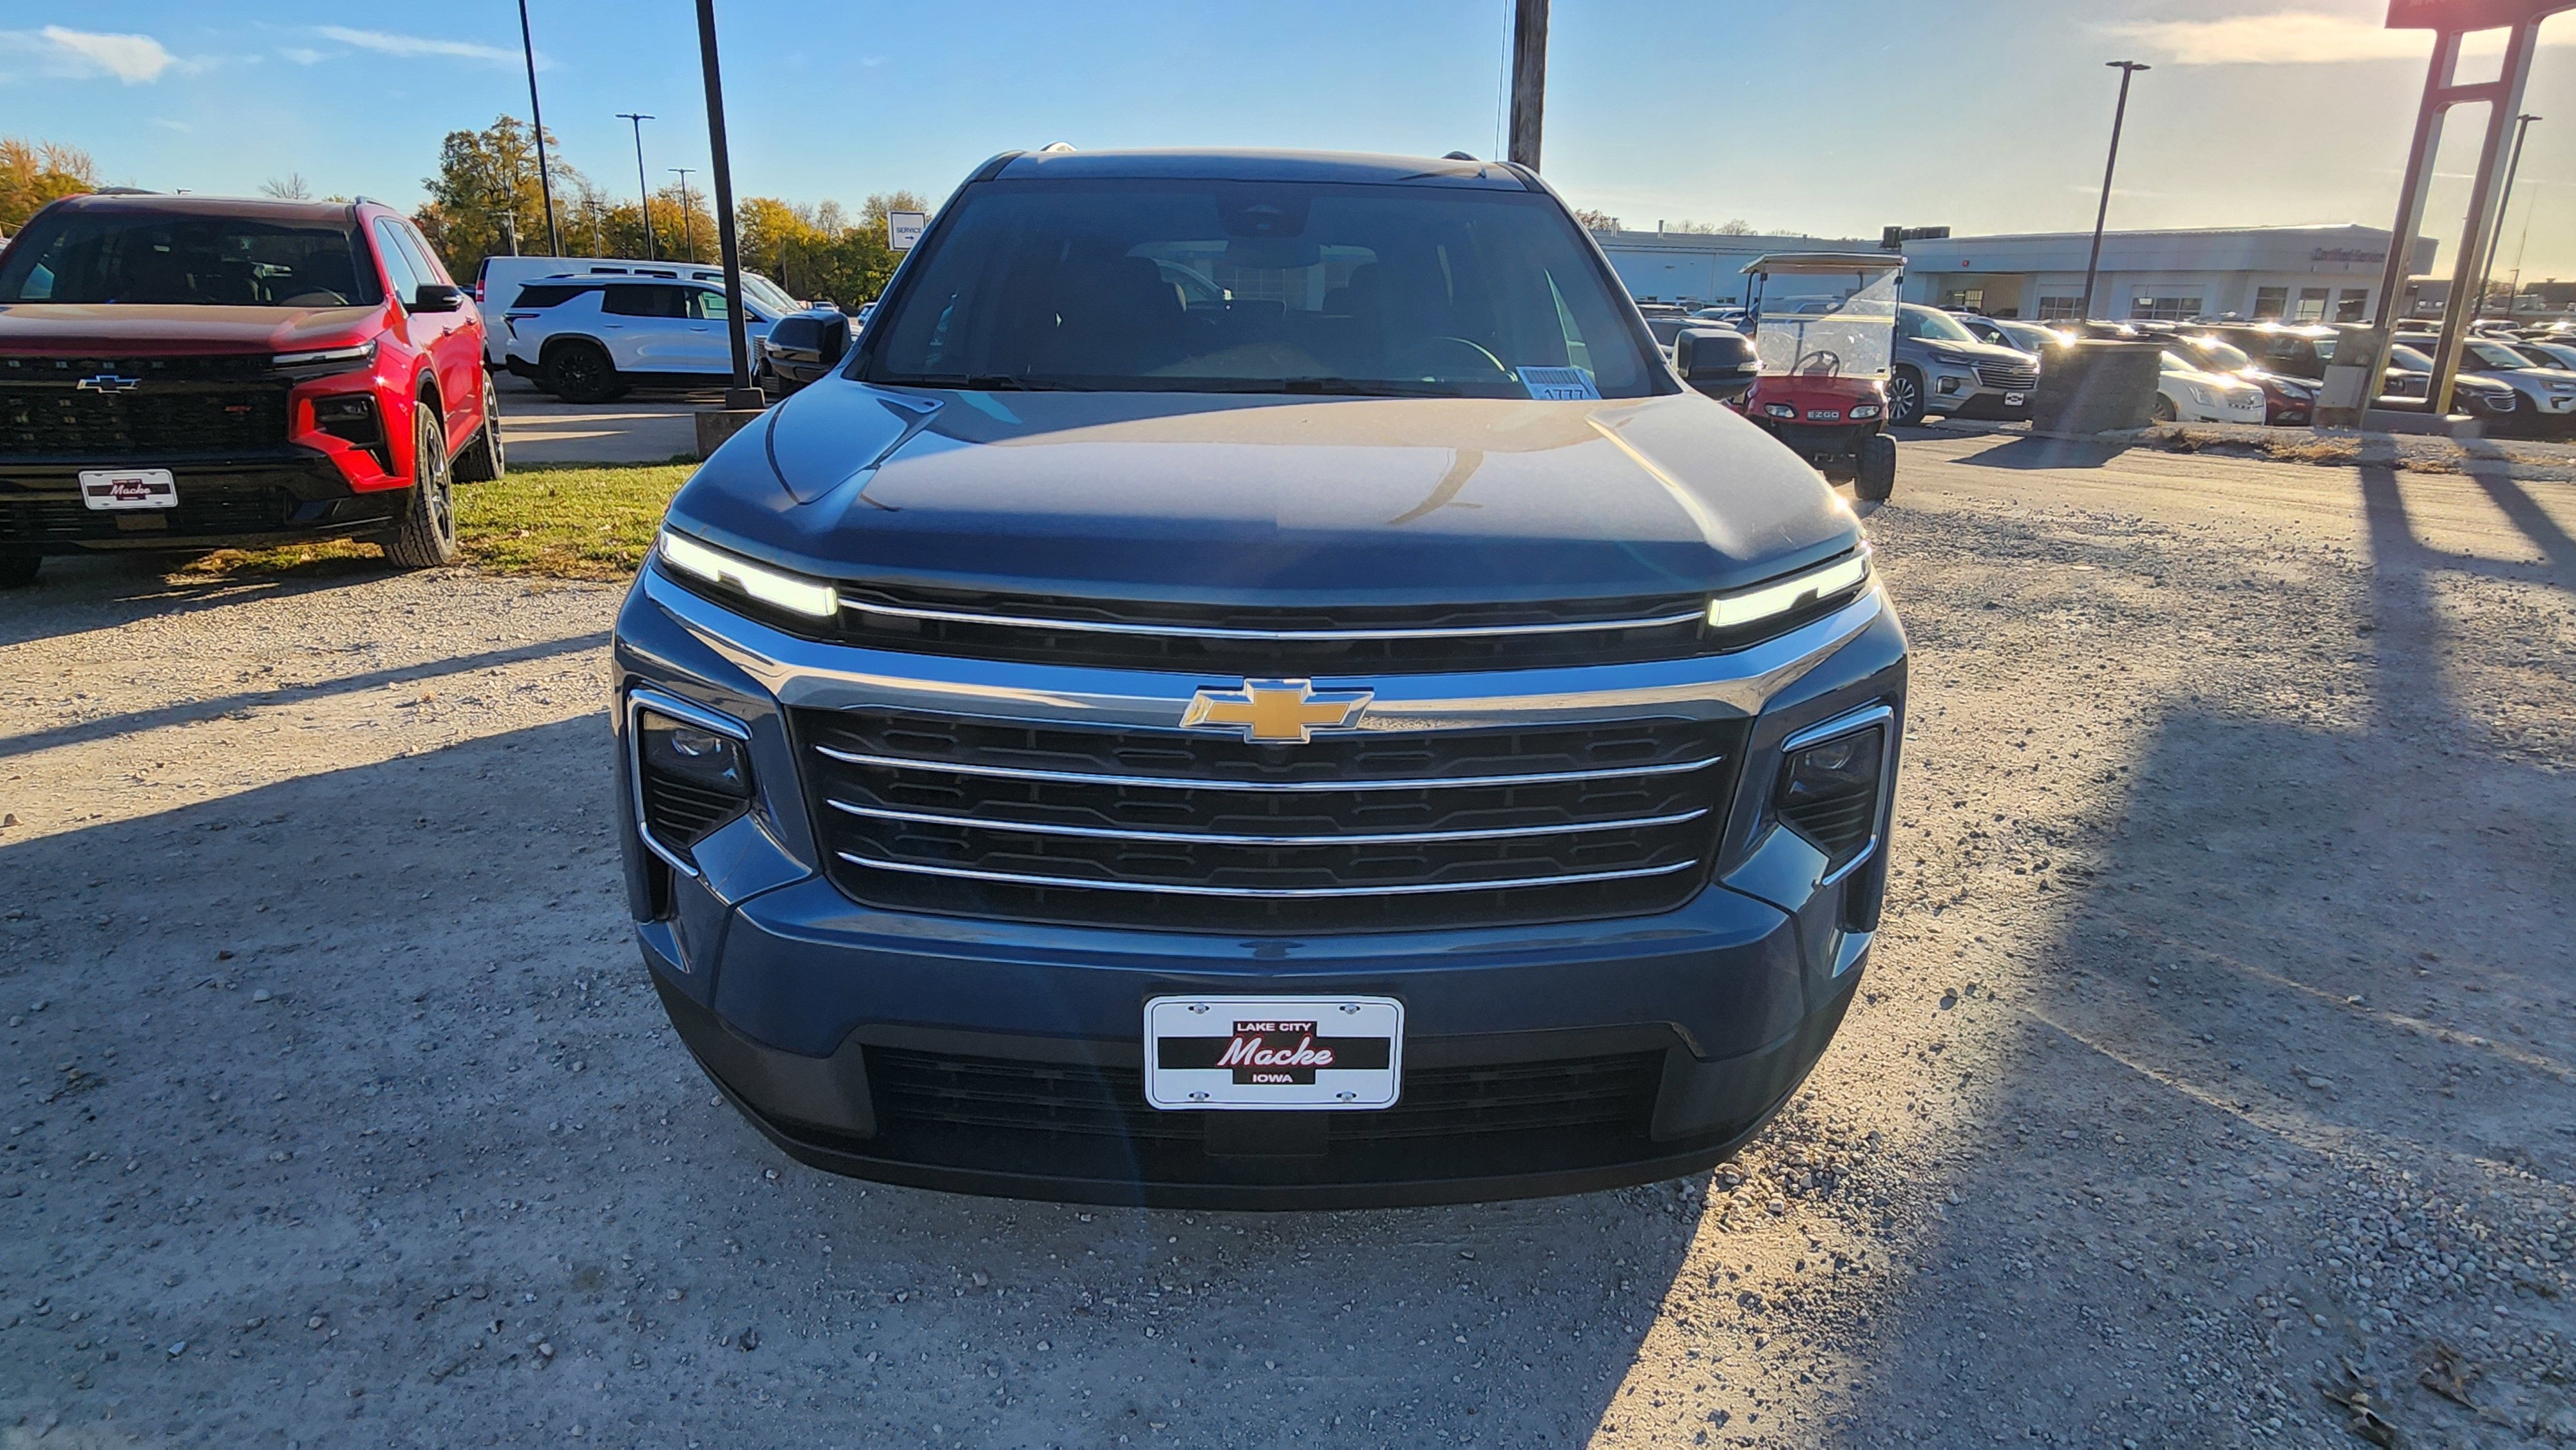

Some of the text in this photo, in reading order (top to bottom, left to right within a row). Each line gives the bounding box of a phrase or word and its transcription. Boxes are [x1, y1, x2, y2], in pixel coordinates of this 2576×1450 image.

[109, 484, 151, 495] Macke
[1236, 1022, 1312, 1031] LAKE CITY
[1217, 1035, 1334, 1066] Macke
[1252, 1073, 1293, 1083] IOWA
